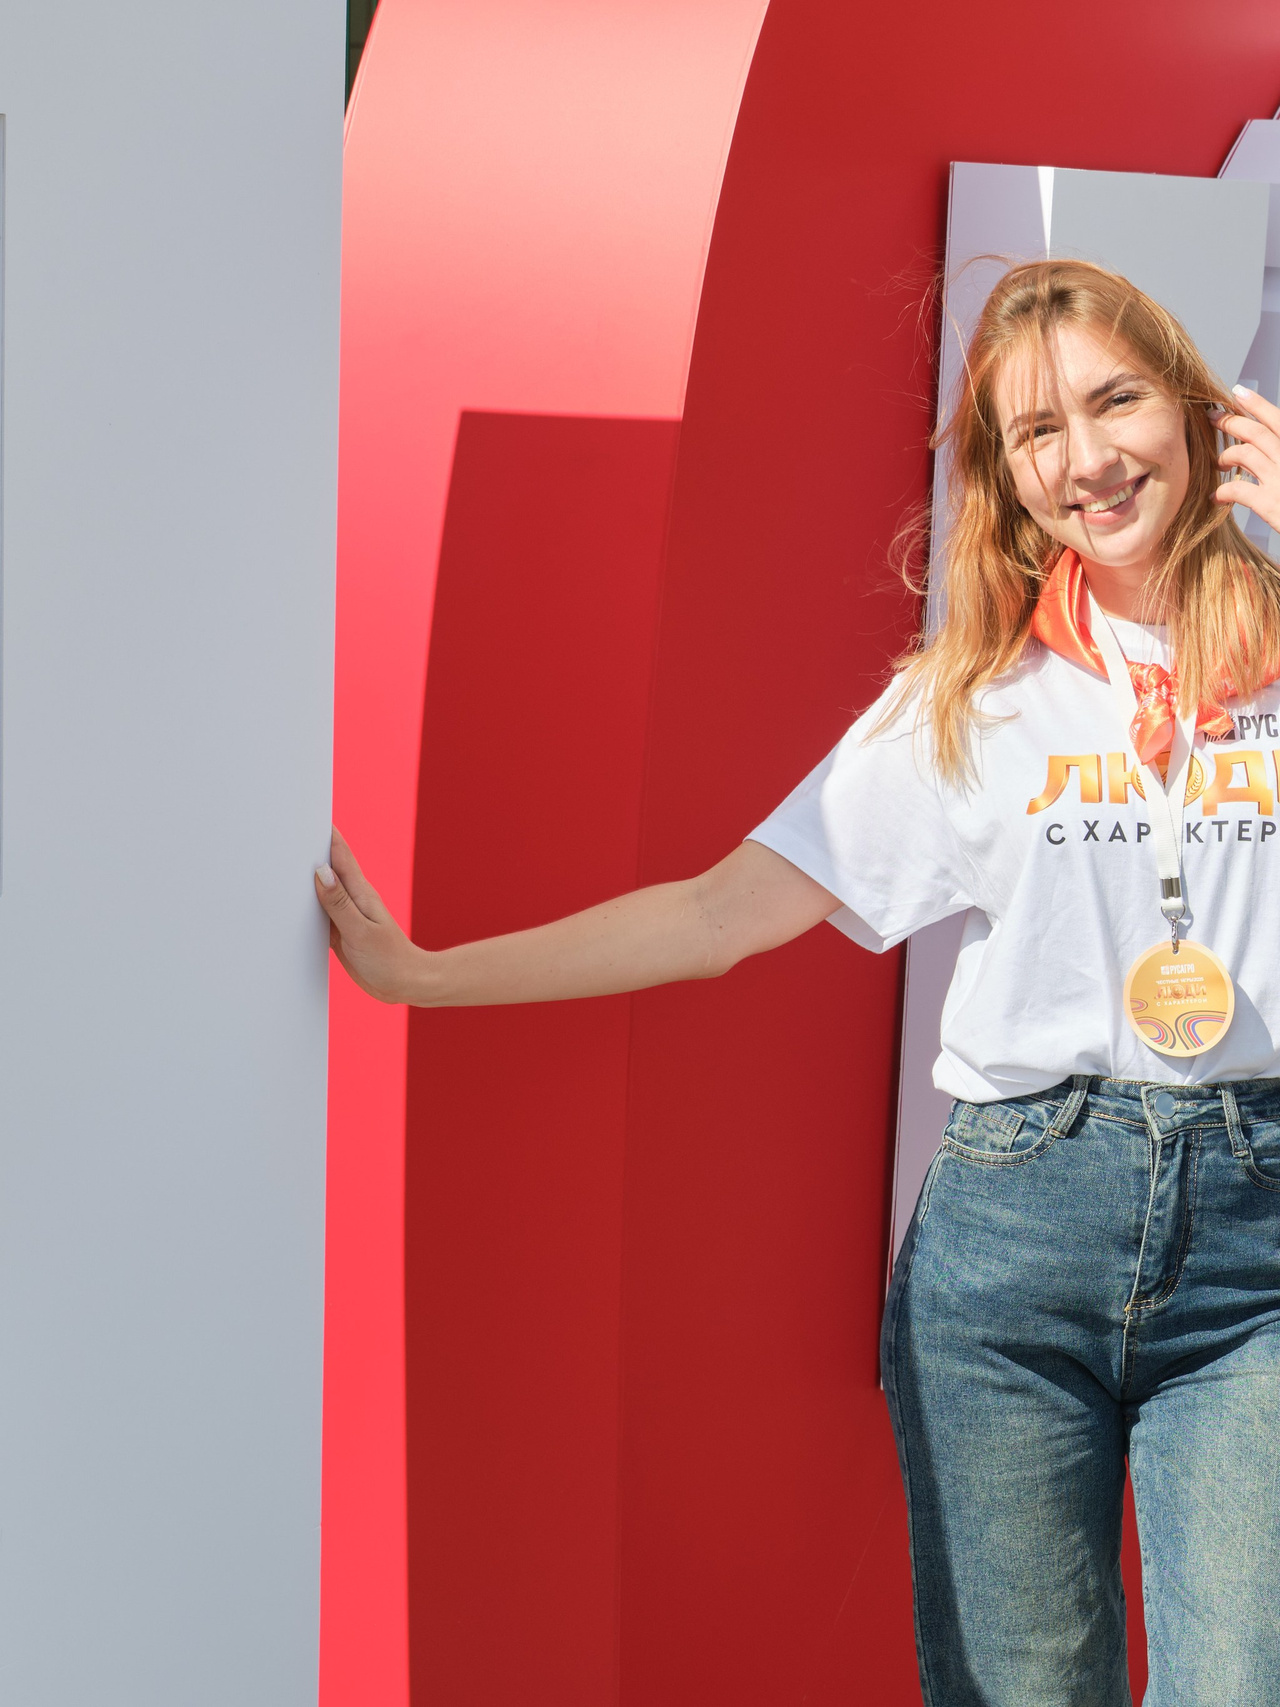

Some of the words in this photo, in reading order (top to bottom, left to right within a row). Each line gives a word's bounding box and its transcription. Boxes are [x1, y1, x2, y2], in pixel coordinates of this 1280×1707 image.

[1046, 823, 1066, 845] С
[1170, 963, 1195, 974] РУСАГРО
[1154, 984, 1207, 1000] ЛЮДИ
